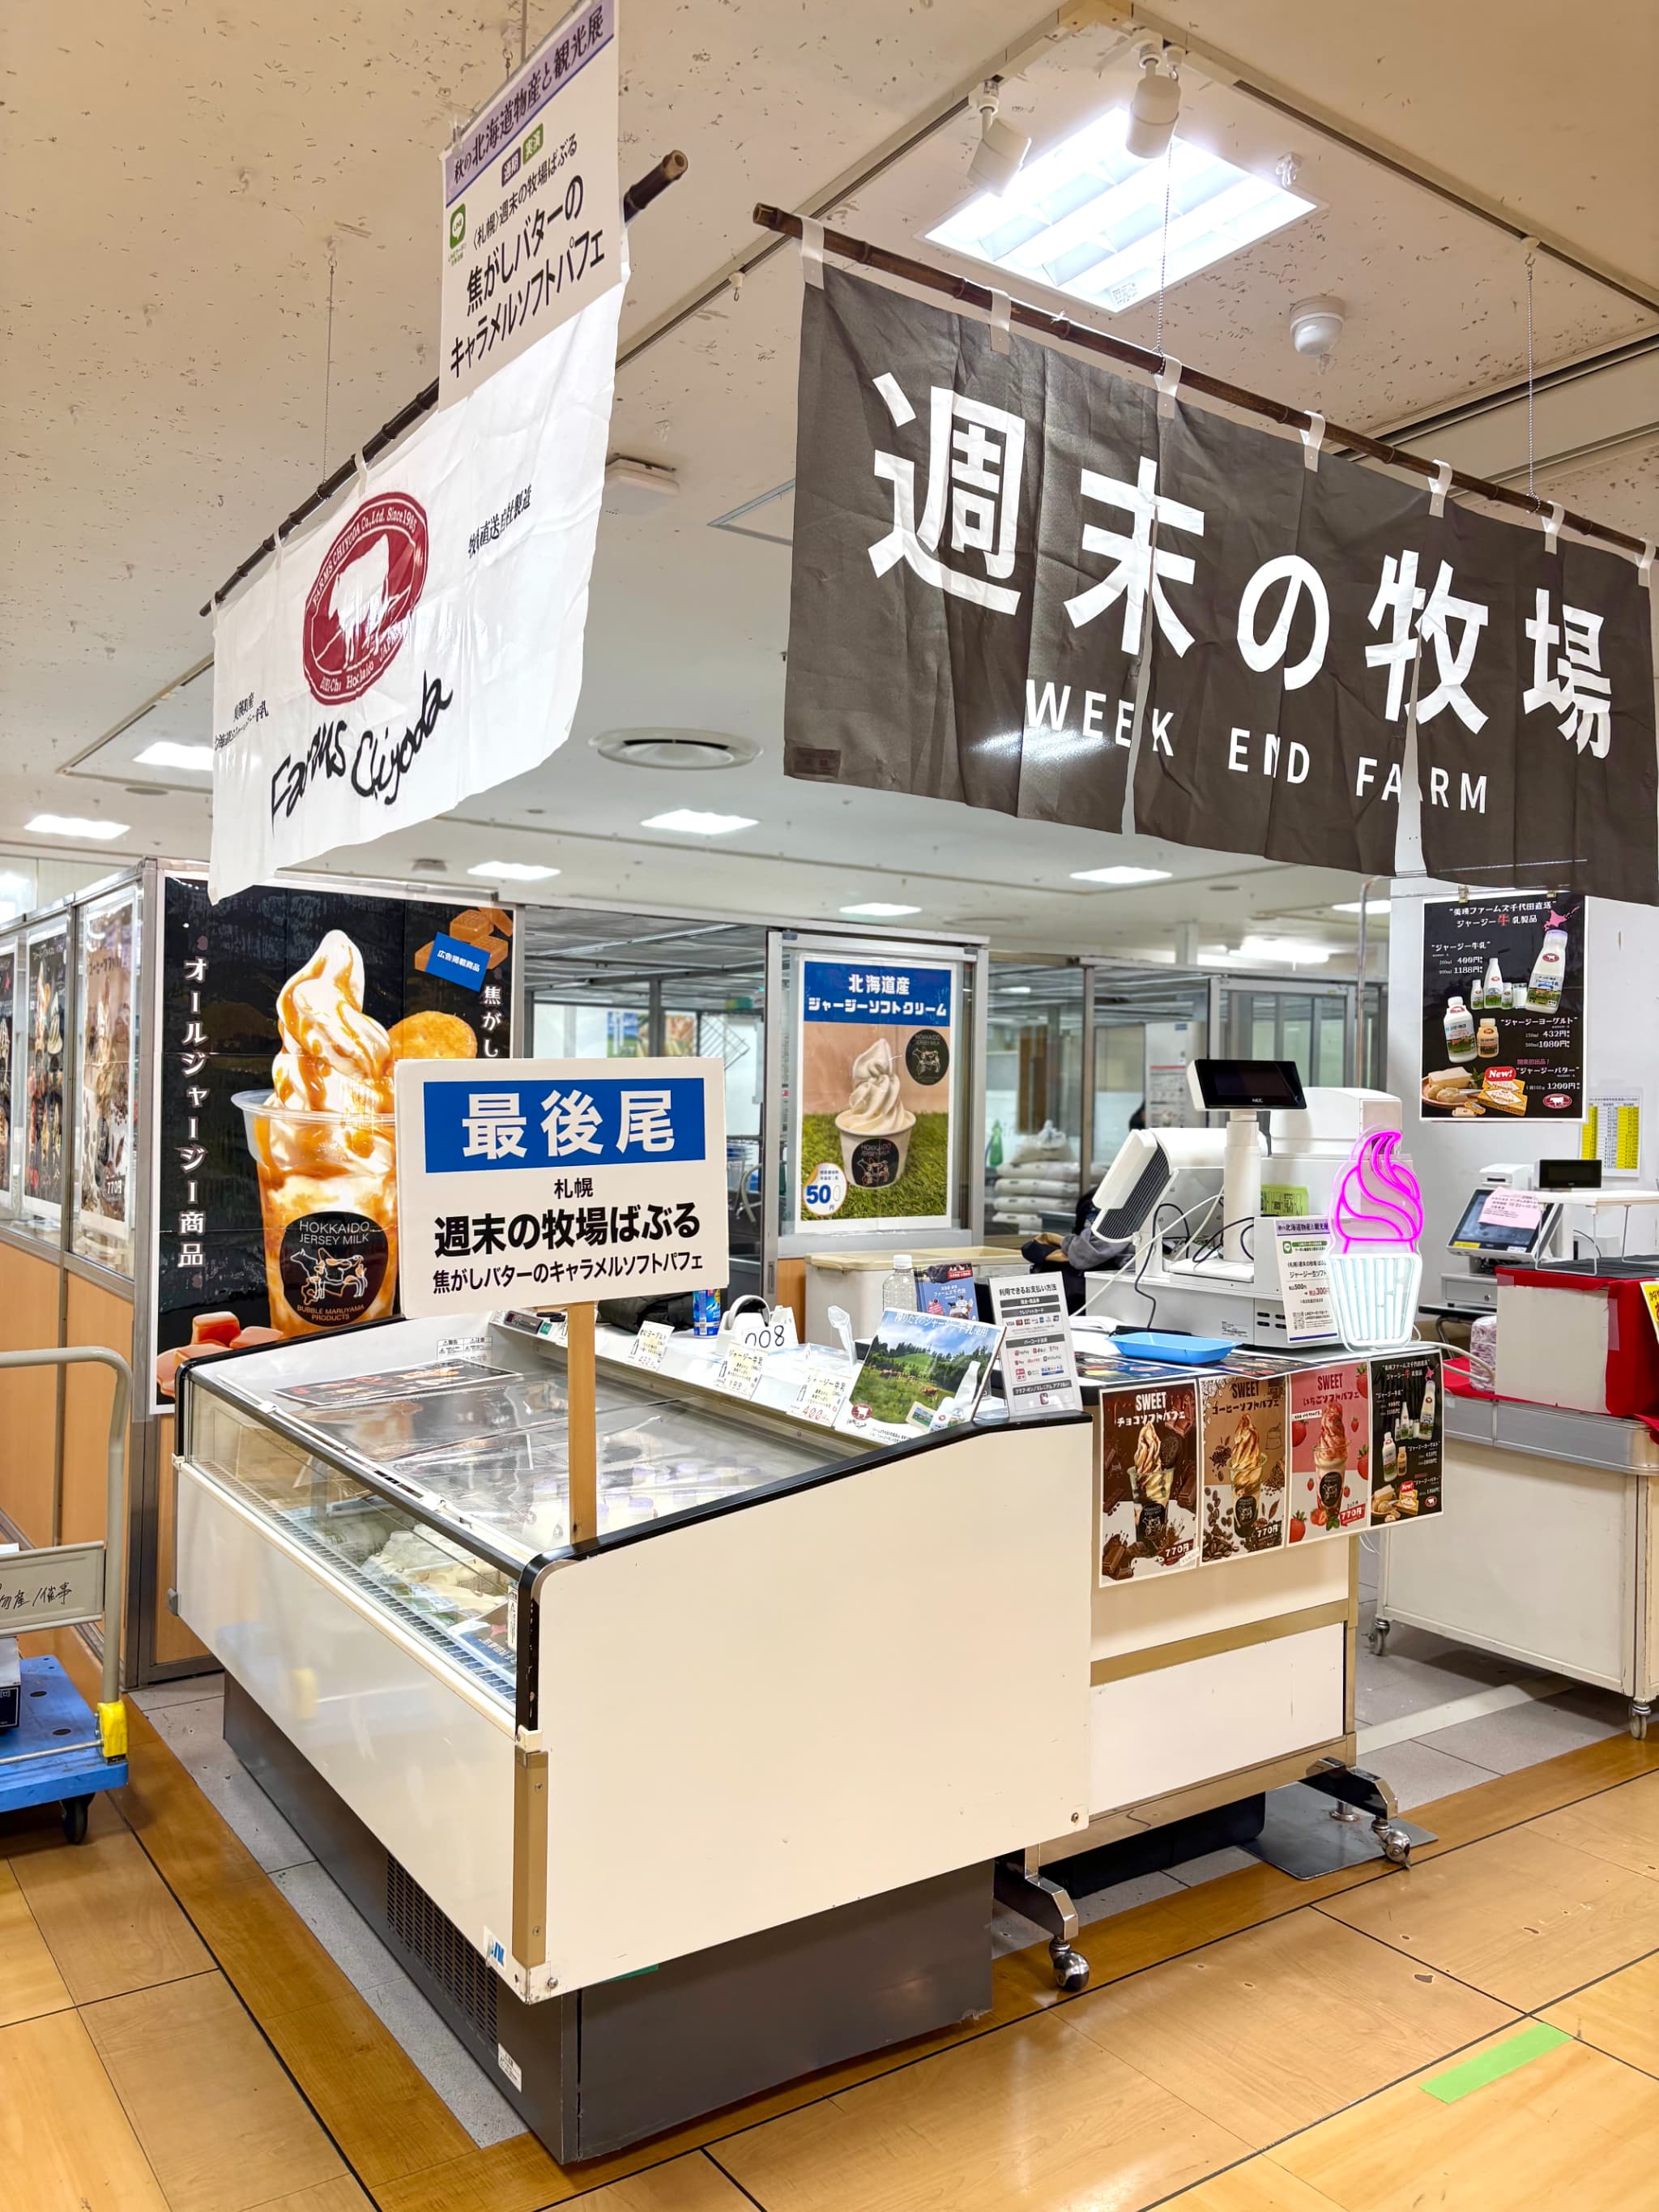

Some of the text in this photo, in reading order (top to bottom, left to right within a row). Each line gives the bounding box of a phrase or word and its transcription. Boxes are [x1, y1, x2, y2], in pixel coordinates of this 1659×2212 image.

[453, 8, 603, 184] 秋の北海道物産と観光展
[467, 175, 584, 316] 焦がしバターの
[450, 230, 605, 378] キャラメルソフトパフェ
[313, 561, 333, 606] FARMS
[332, 523, 360, 566] CHIYODA
[866, 371, 1613, 759] 週末の牧場
[1026, 678, 1488, 814] WEEK END FARM
[437, 950, 480, 972] 広告掲載商品
[848, 974, 911, 996] 北海道産
[808, 997, 947, 1016] ジャージーソフトクリーム
[483, 986, 502, 1057] 焦がし
[1488, 1070, 1513, 1079] New!
[177, 958, 210, 1268] オールジャージー商品
[462, 1089, 676, 1159] 最後尾
[553, 1177, 594, 1200] 札幌
[300, 1219, 370, 1235] HOKKAIDO
[434, 1202, 701, 1258] 週末の牧場ばぶる
[300, 1233, 369, 1245] JERSEY MILK
[433, 1251, 703, 1295] 焦がしバターのキャラメルソフトパフェ
[1000, 1283, 1057, 1296] 利用できるお支払い方法
[296, 1304, 365, 1314] BUBBLE MARUYAMA
[1232, 1381, 1260, 1399] SWEET
[1317, 1373, 1343, 1390] SWEET
[1136, 1391, 1166, 1411] SWEET
[1212, 1399, 1279, 1414] コーヒーソフトパフェ
[1303, 1391, 1360, 1406] いちごソフトパフェ
[1117, 1411, 1185, 1427] チョコソフトパフェ
[1341, 1508, 1362, 1520] 770円
[1257, 1525, 1278, 1538] 770円
[1165, 1543, 1189, 1557] 770円
